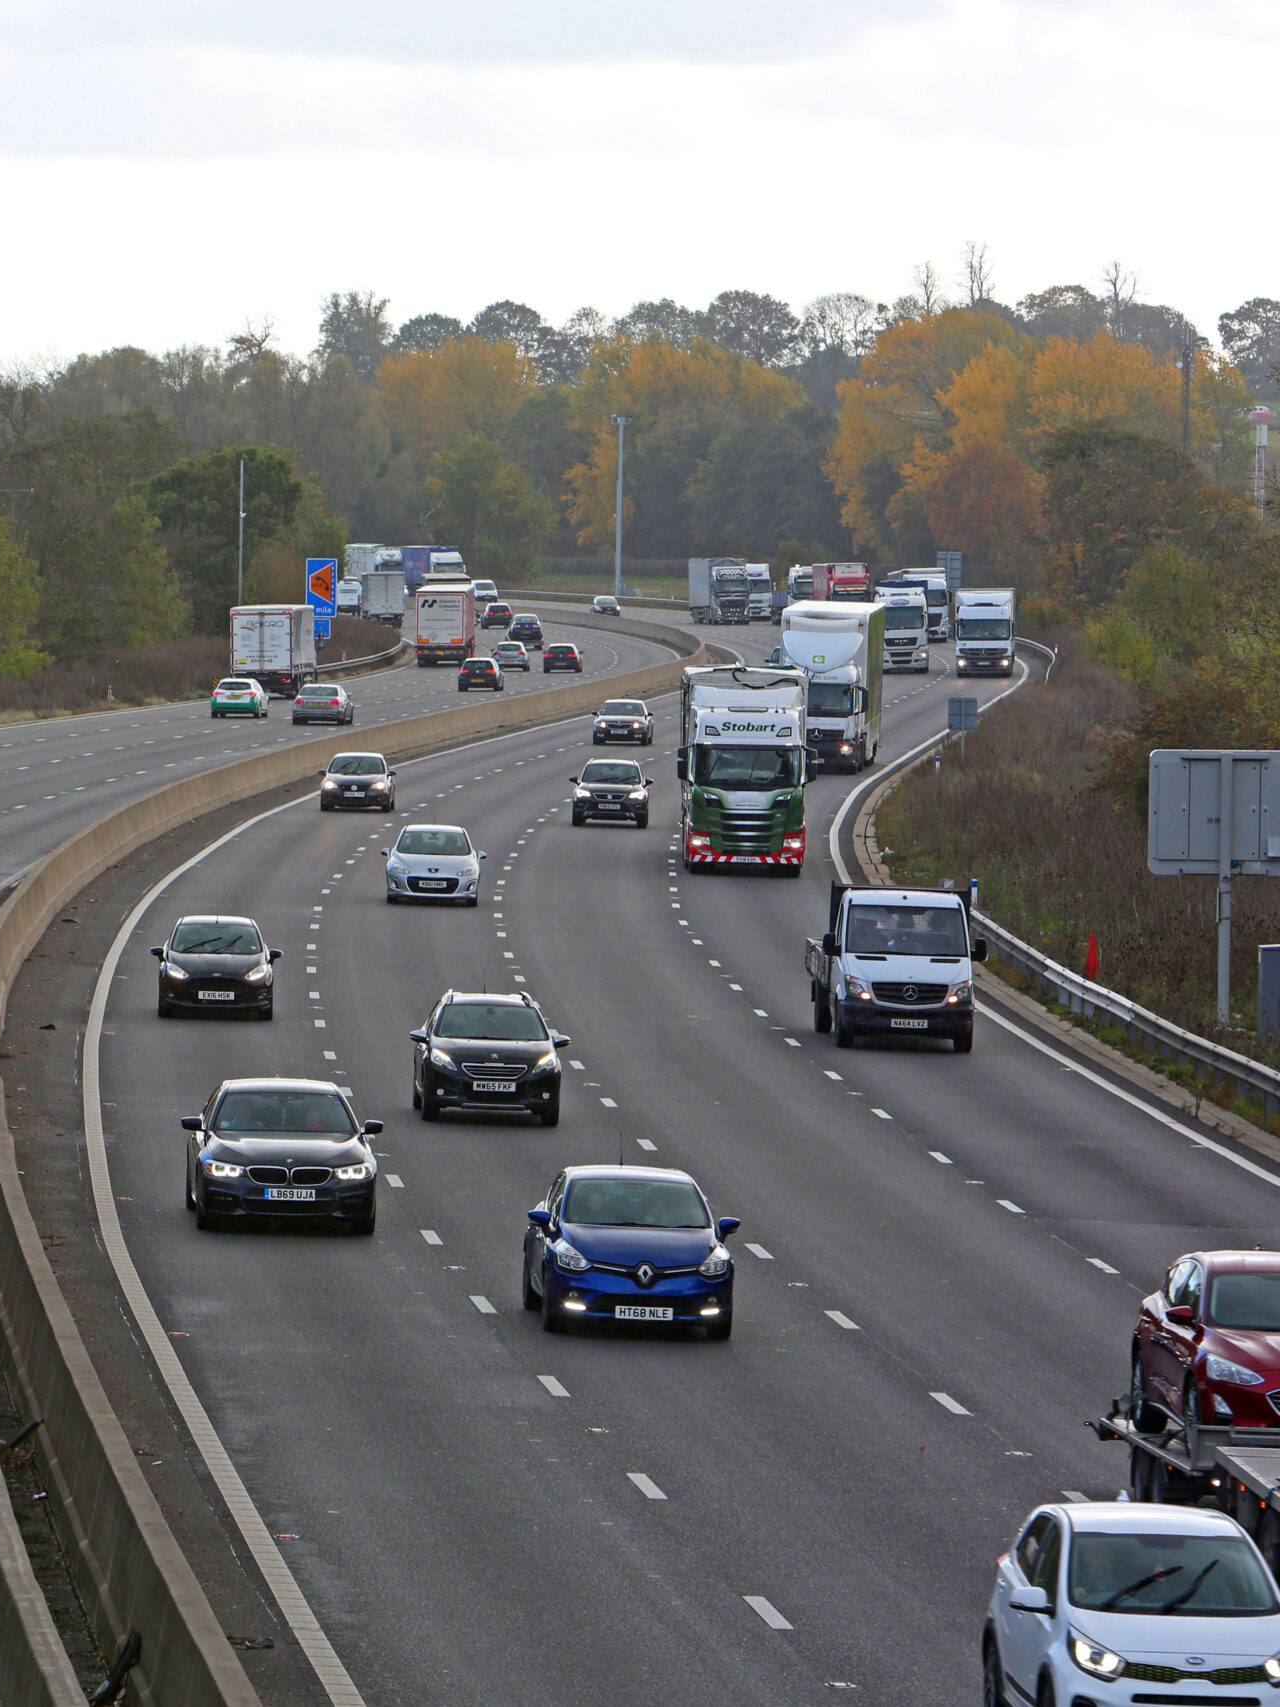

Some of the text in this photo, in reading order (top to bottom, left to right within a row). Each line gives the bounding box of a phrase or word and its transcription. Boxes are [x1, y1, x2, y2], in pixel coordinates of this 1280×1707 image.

[721, 721, 776, 732] Stobart
[202, 991, 217, 999] EX16
[476, 1082, 496, 1090] MW65
[270, 1190, 314, 1199] LB69 UJA
[619, 1307, 669, 1319] HT68 NLE
